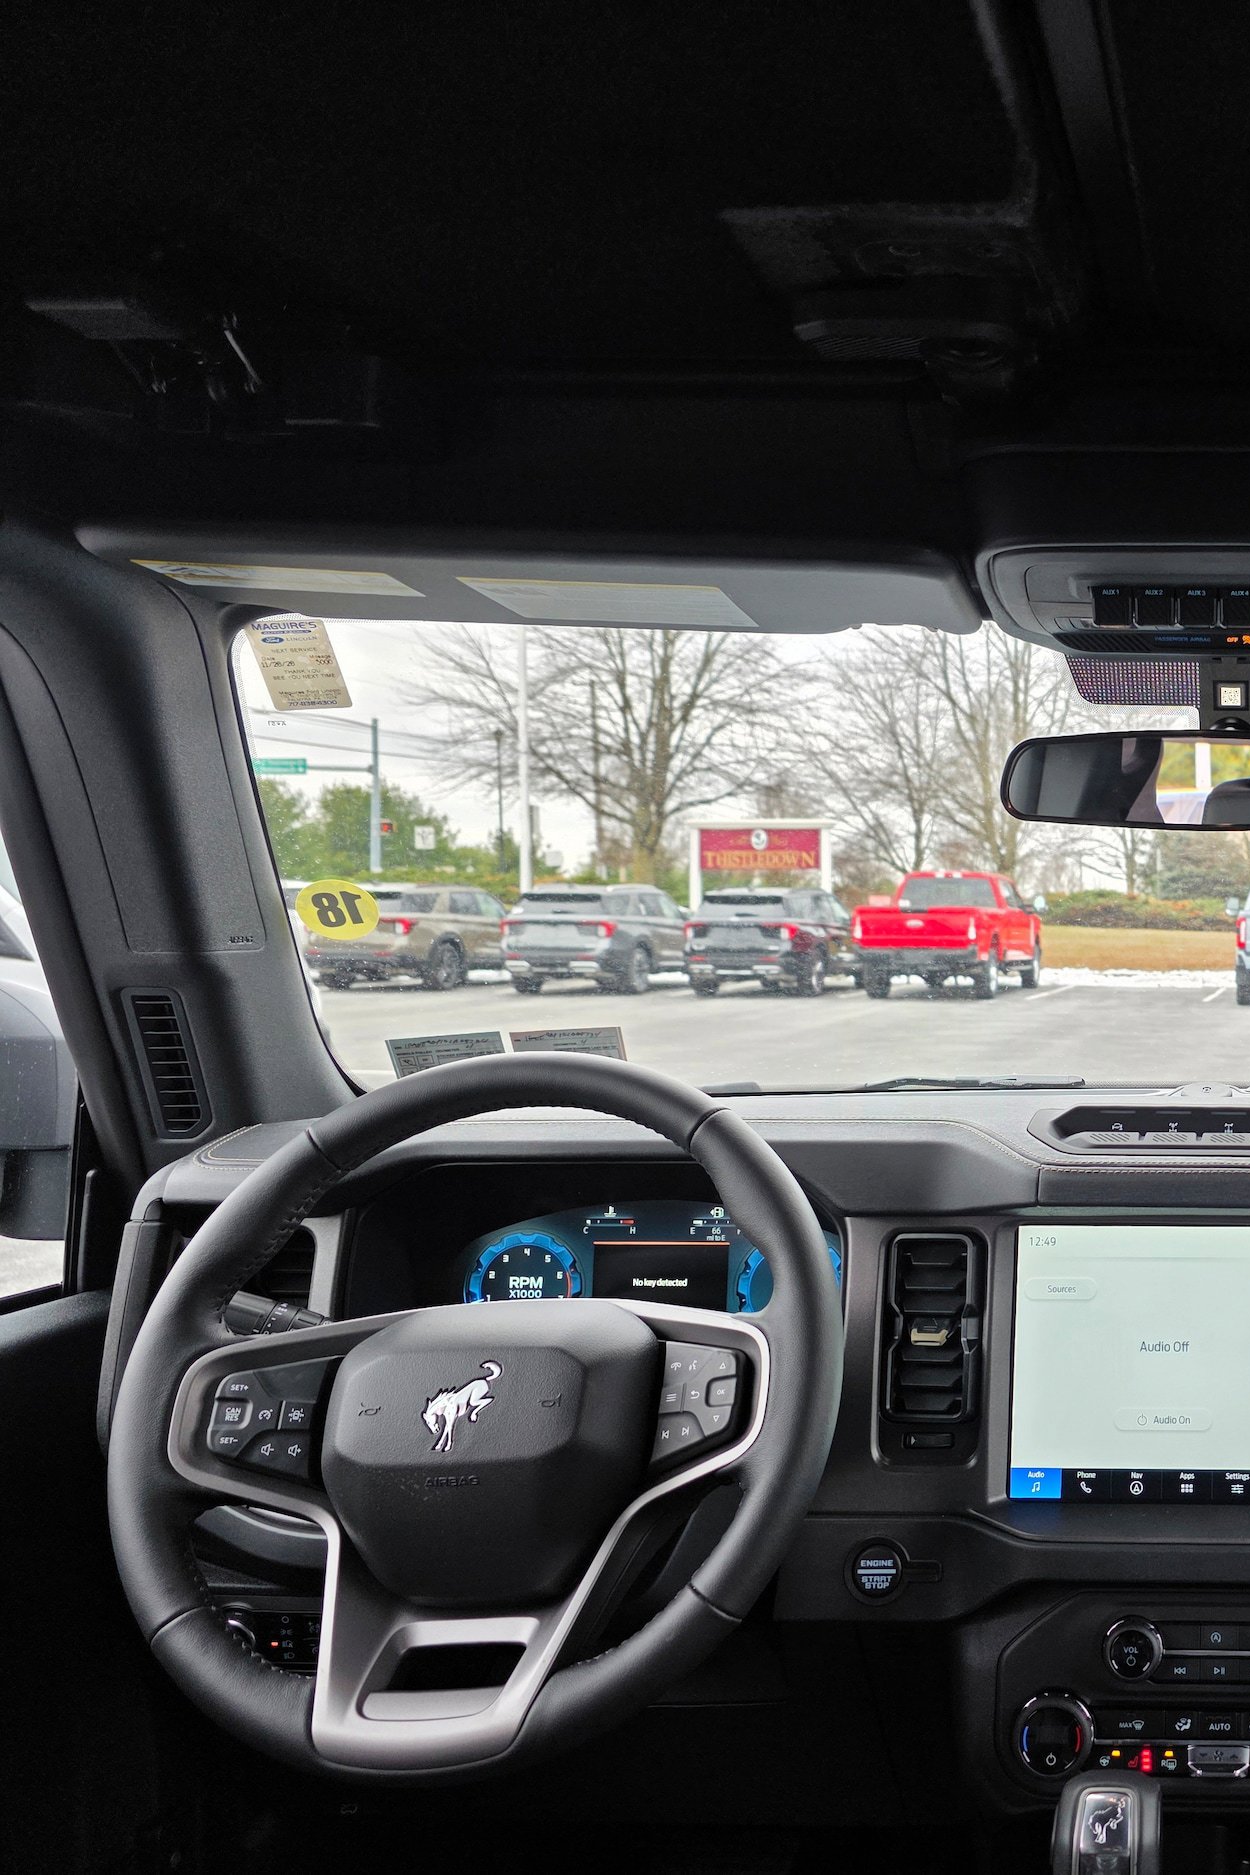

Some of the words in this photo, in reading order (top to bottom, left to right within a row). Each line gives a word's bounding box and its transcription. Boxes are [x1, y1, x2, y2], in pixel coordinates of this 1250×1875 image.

[251, 621, 317, 631] MAGUIRE'S
[703, 850, 816, 868] THISTLEDOWN
[690, 1227, 696, 1235] E
[711, 1227, 721, 1235] 66
[1029, 1236, 1057, 1247] 12:49
[524, 1248, 531, 1256] 4
[502, 1254, 509, 1263] 3
[545, 1254, 551, 1263] 5
[488, 1271, 496, 1279] 2
[557, 1271, 563, 1279] 6
[509, 1276, 544, 1289] RPM
[633, 1278, 643, 1287] No
[644, 1278, 656, 1288] key
[656, 1278, 688, 1287] detected
[509, 1289, 542, 1298] X1000
[1047, 1284, 1077, 1294] Sources
[1139, 1341, 1171, 1352] Audio
[1173, 1341, 1190, 1352] Off
[1153, 1415, 1177, 1424] Audio
[1178, 1415, 1191, 1424] On
[1027, 1471, 1045, 1479] Audio
[1076, 1471, 1096, 1479] Phone
[1130, 1471, 1143, 1480] Nav
[1179, 1472, 1195, 1481] Apps
[1225, 1472, 1250, 1481] Settings
[424, 1475, 479, 1487] AIRBAG
[861, 1575, 893, 1583] START
[1123, 1646, 1139, 1654] VOL
[1208, 1723, 1231, 1731] AUTO
